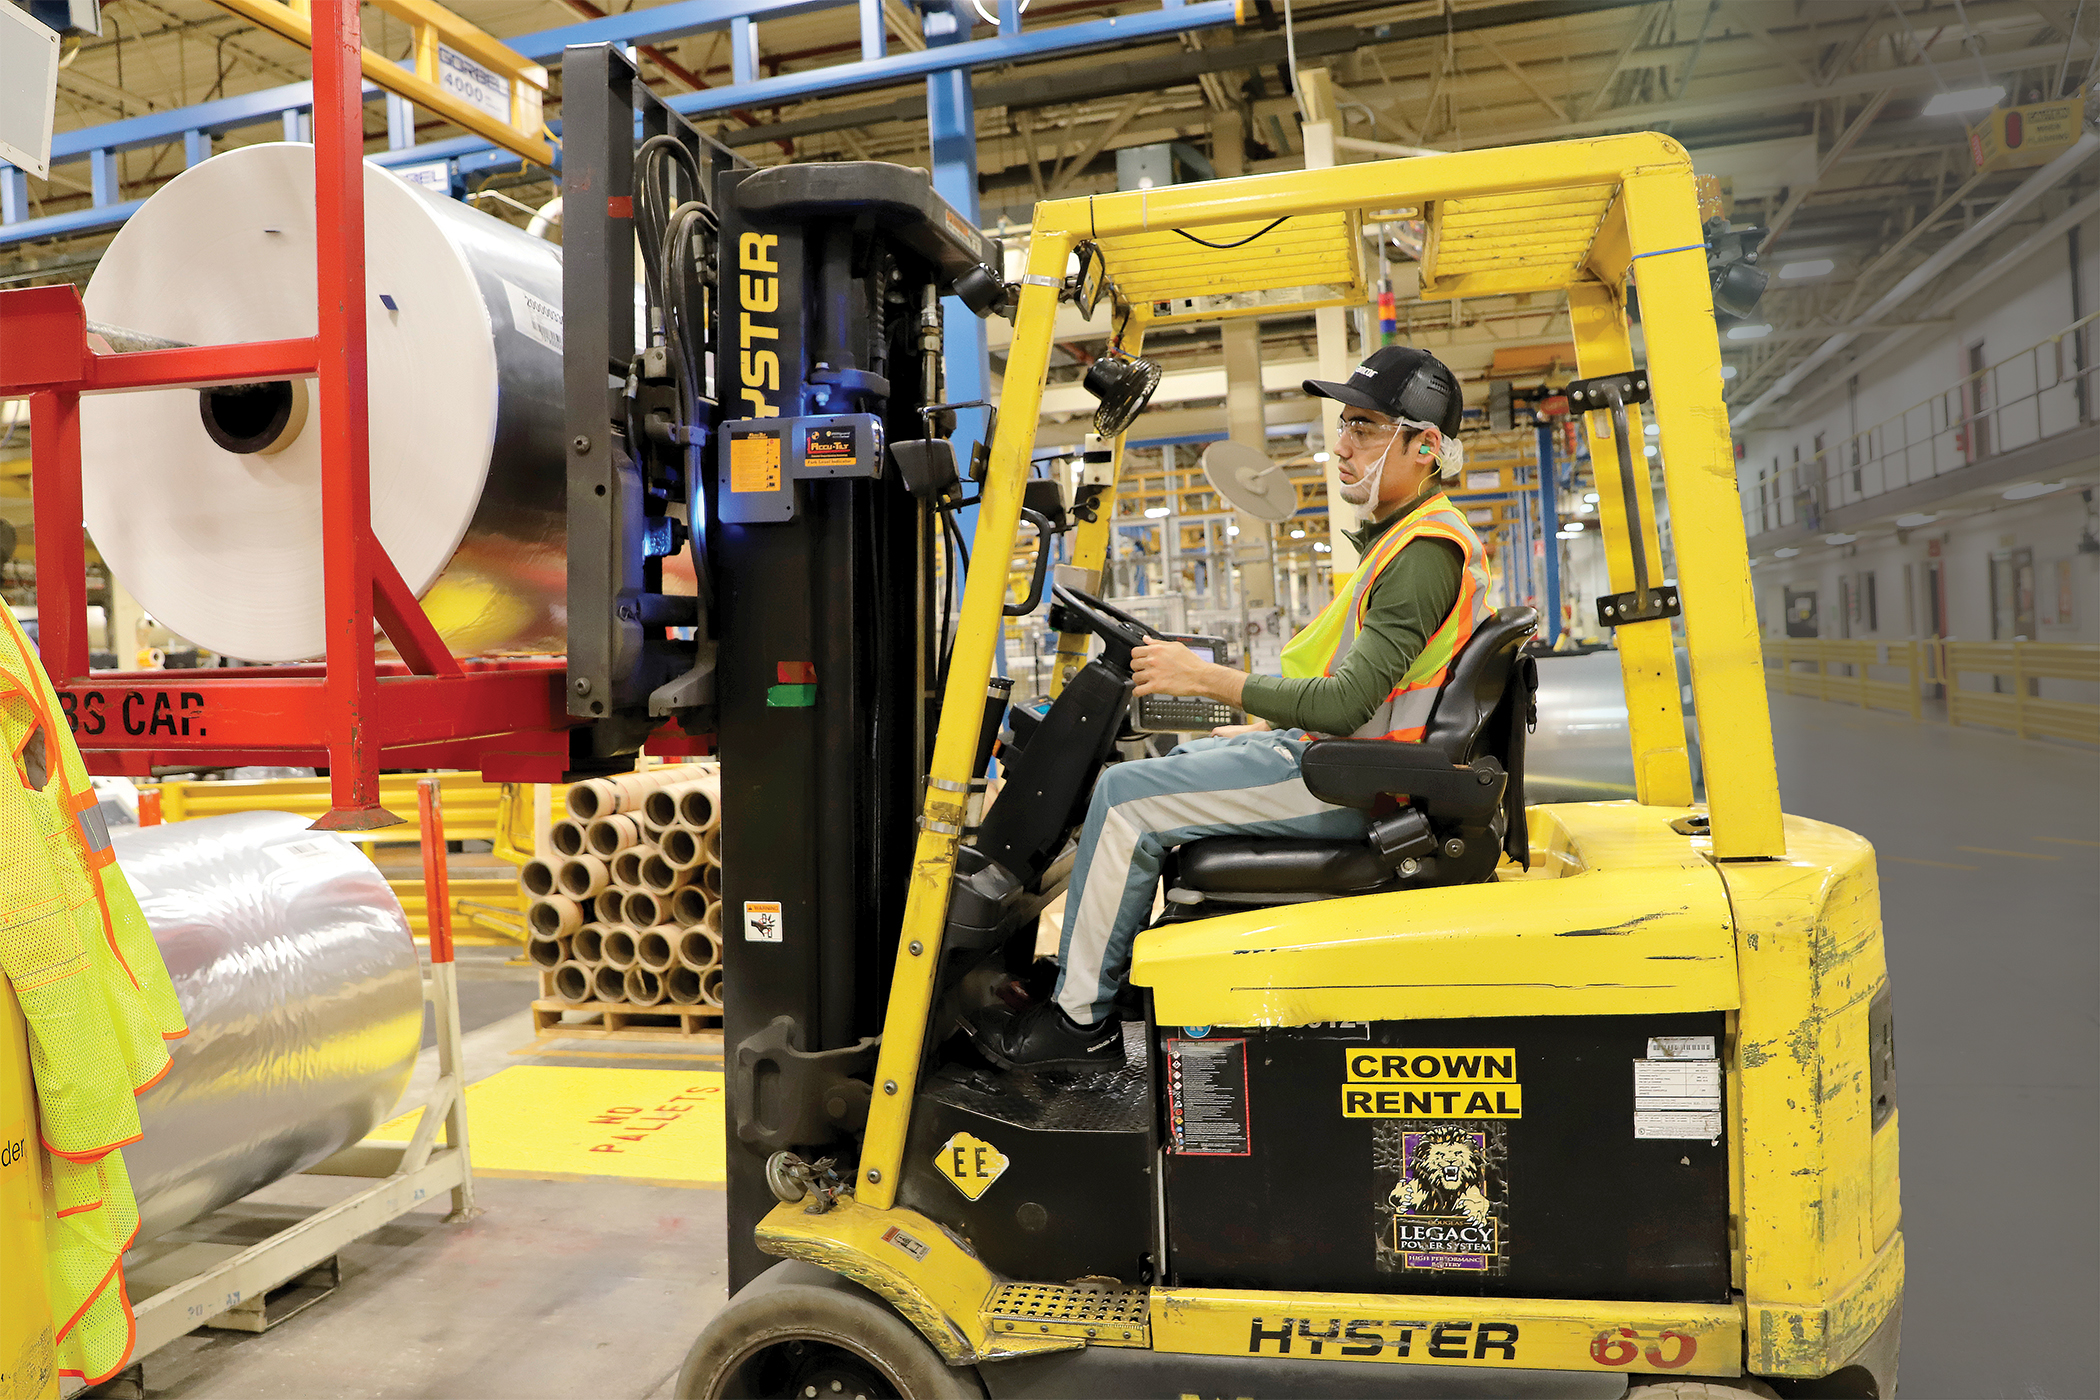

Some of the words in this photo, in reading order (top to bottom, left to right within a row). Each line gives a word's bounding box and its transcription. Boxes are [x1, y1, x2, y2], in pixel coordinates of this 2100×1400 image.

[444, 72, 484, 102] 4000
[739, 231, 780, 421] YSTER
[1351, 1055, 1513, 1078] CROWN
[587, 1106, 644, 1125] NO
[1346, 1091, 1520, 1114] RENTAL
[588, 1086, 721, 1153] PALLETS
[0, 1138, 25, 1168] der
[1400, 1225, 1494, 1242] LEGACY
[1248, 1316, 1519, 1361] HYSTER
[1590, 1327, 1698, 1370] 60
